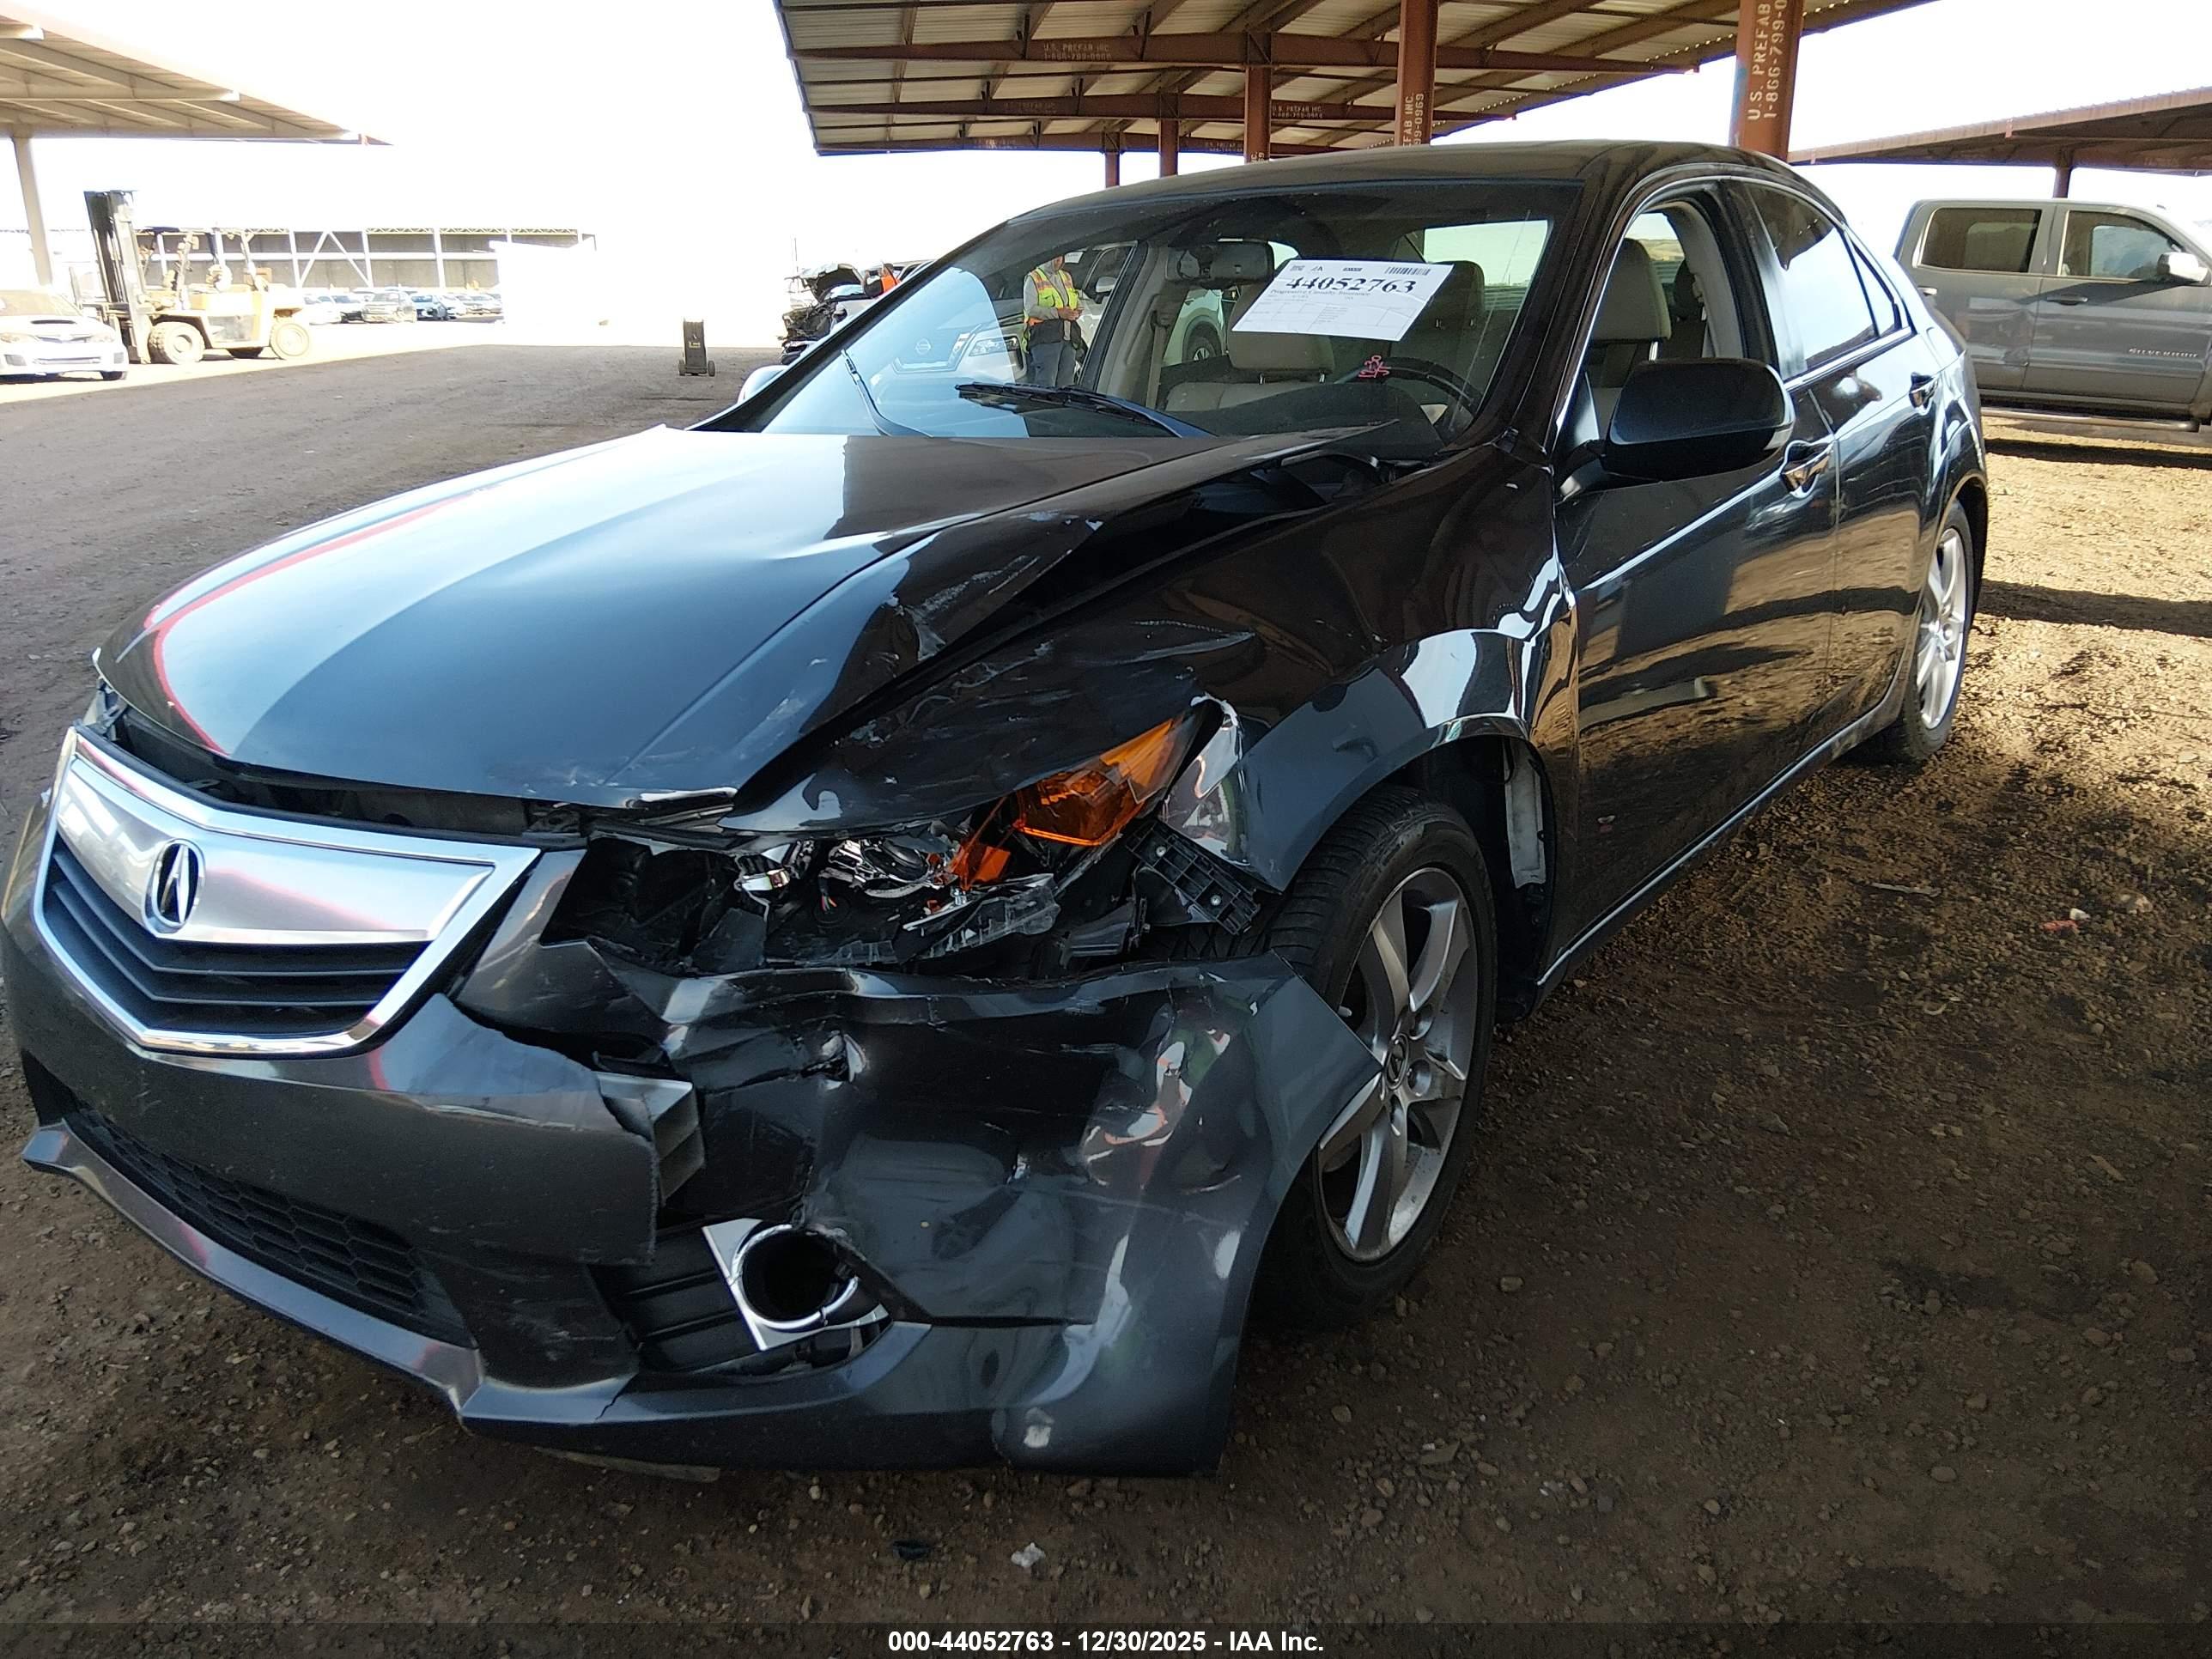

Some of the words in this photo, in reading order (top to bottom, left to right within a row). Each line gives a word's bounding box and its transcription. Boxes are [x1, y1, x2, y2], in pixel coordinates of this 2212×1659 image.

[1752, 3, 1771, 75] PREFAB
[1748, 85, 1765, 120] U.S.
[1286, 276, 1417, 293] 44052763
